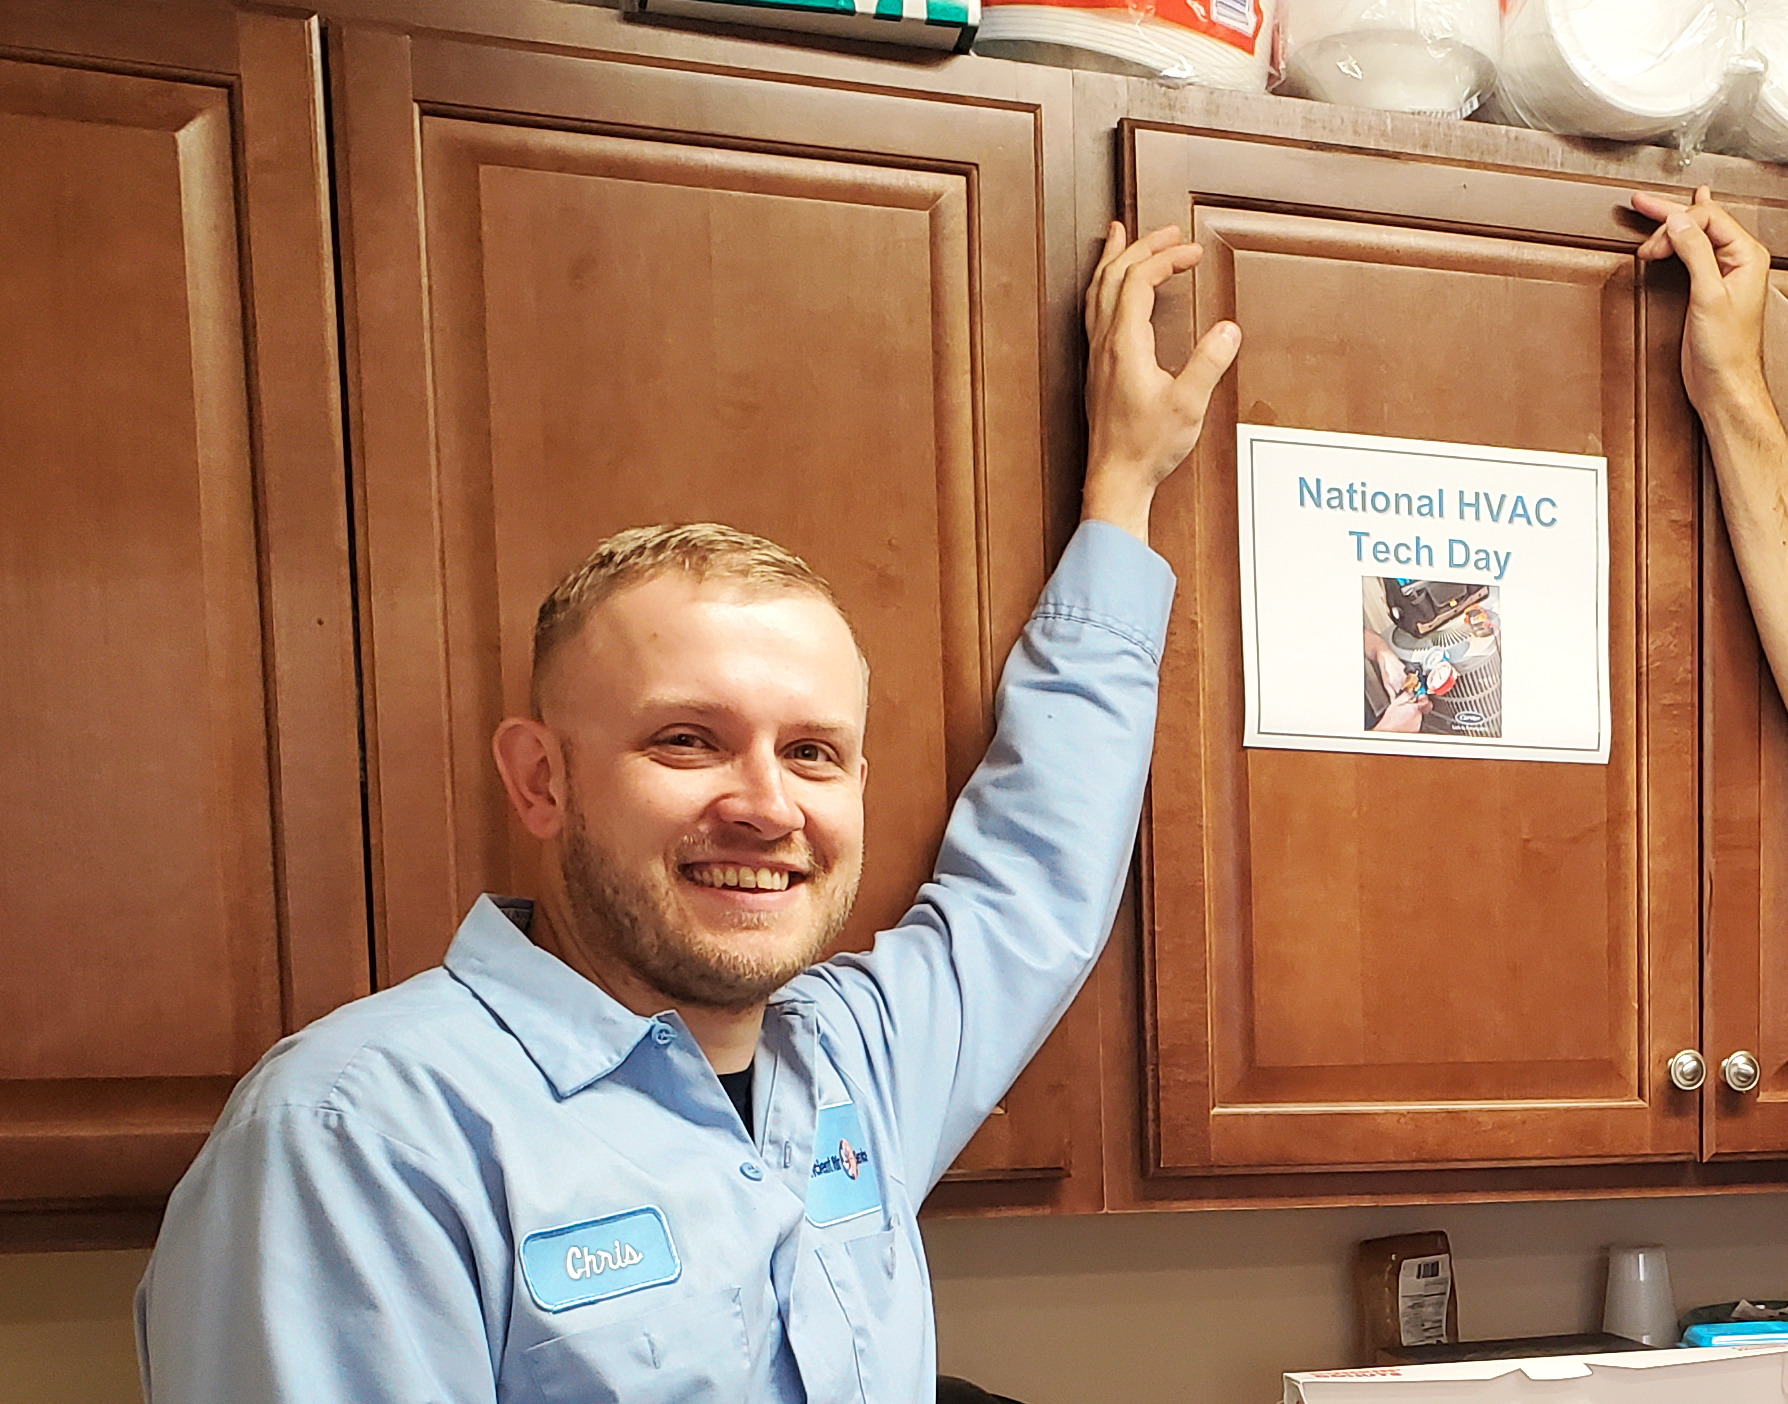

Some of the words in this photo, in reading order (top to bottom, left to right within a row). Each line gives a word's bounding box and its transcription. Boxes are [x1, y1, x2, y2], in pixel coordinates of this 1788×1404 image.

[1298, 476, 1445, 518] National
[1458, 489, 1558, 528] HVAC
[1348, 530, 1434, 567] Tech
[1448, 537, 1512, 580] Day
[564, 1239, 643, 1280] Chris
